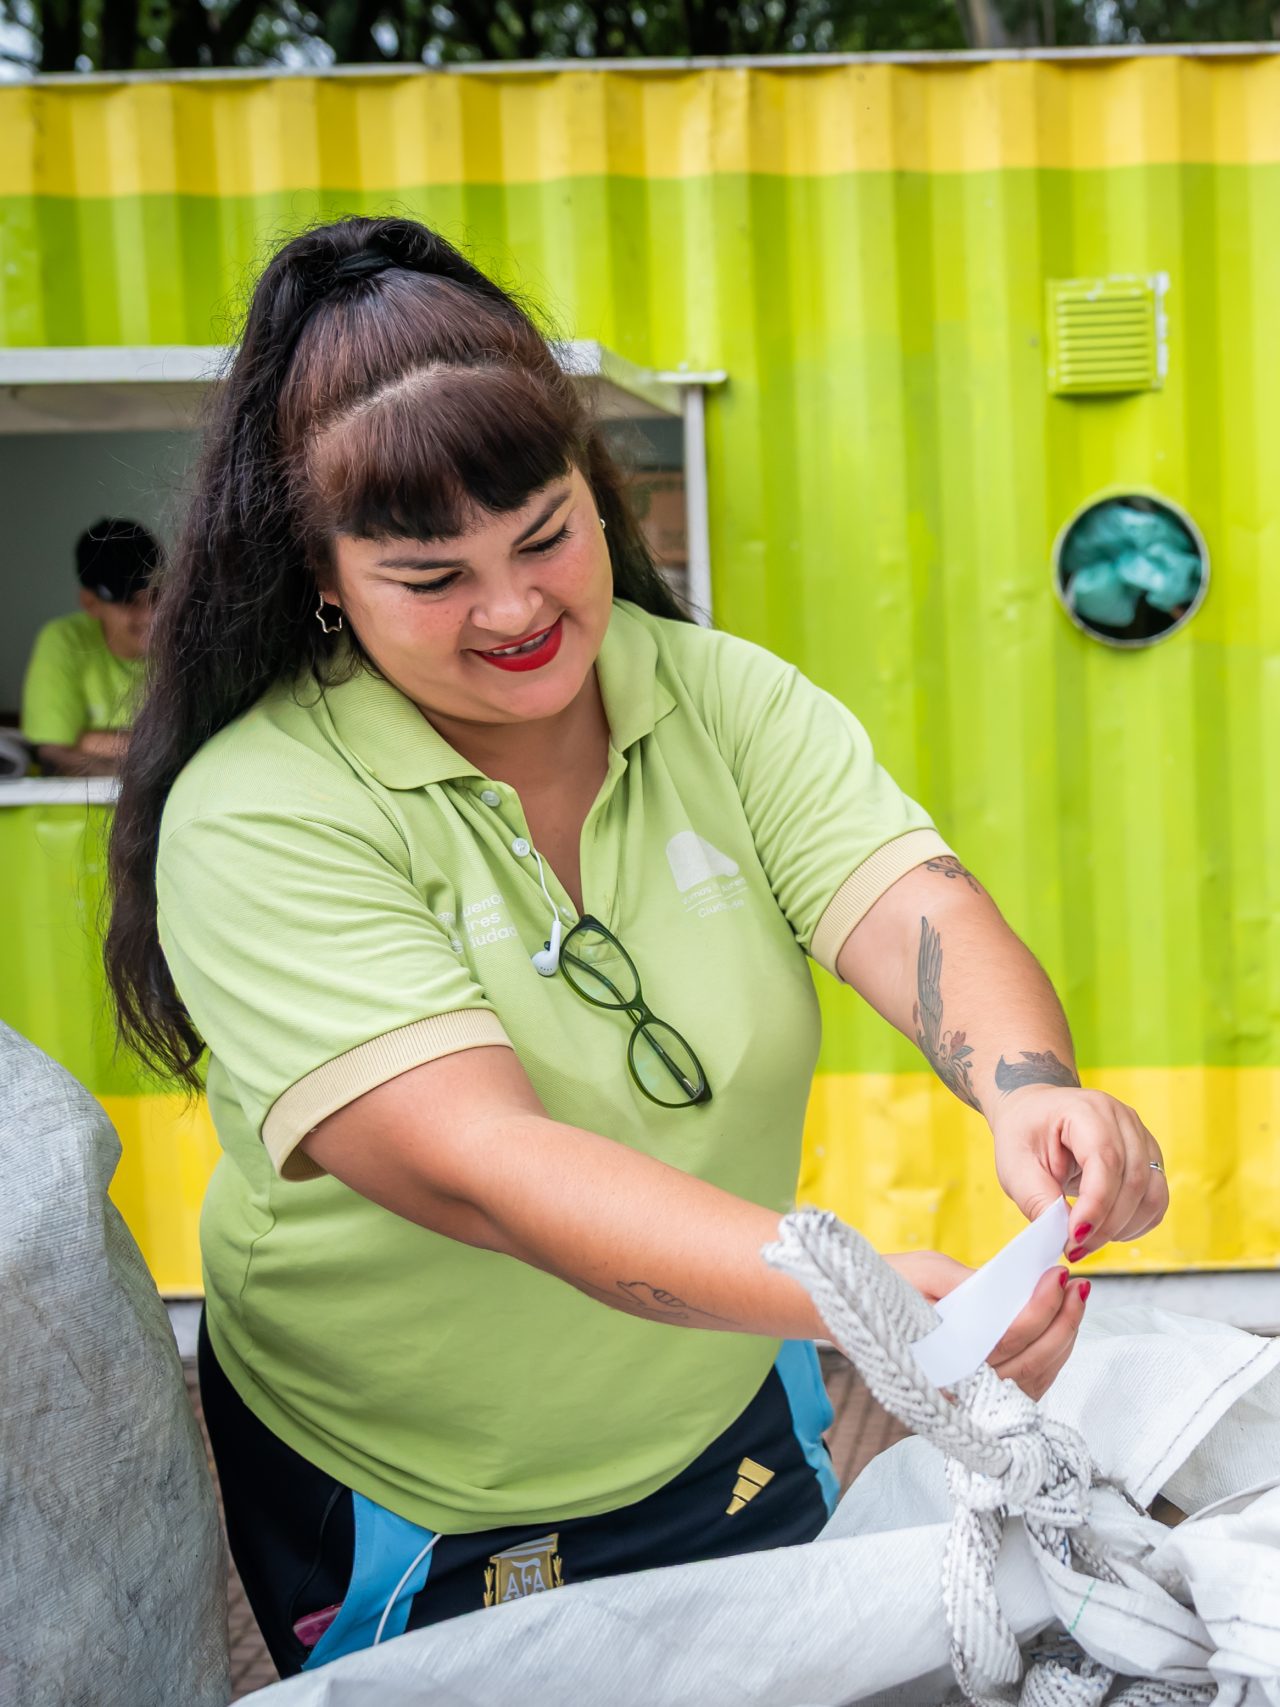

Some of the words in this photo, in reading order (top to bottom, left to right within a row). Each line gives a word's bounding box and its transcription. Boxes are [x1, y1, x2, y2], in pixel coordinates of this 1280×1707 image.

[463, 894, 505, 917] ueno
[465, 912, 500, 933] ires
[502, 1557, 547, 1601] AFA
